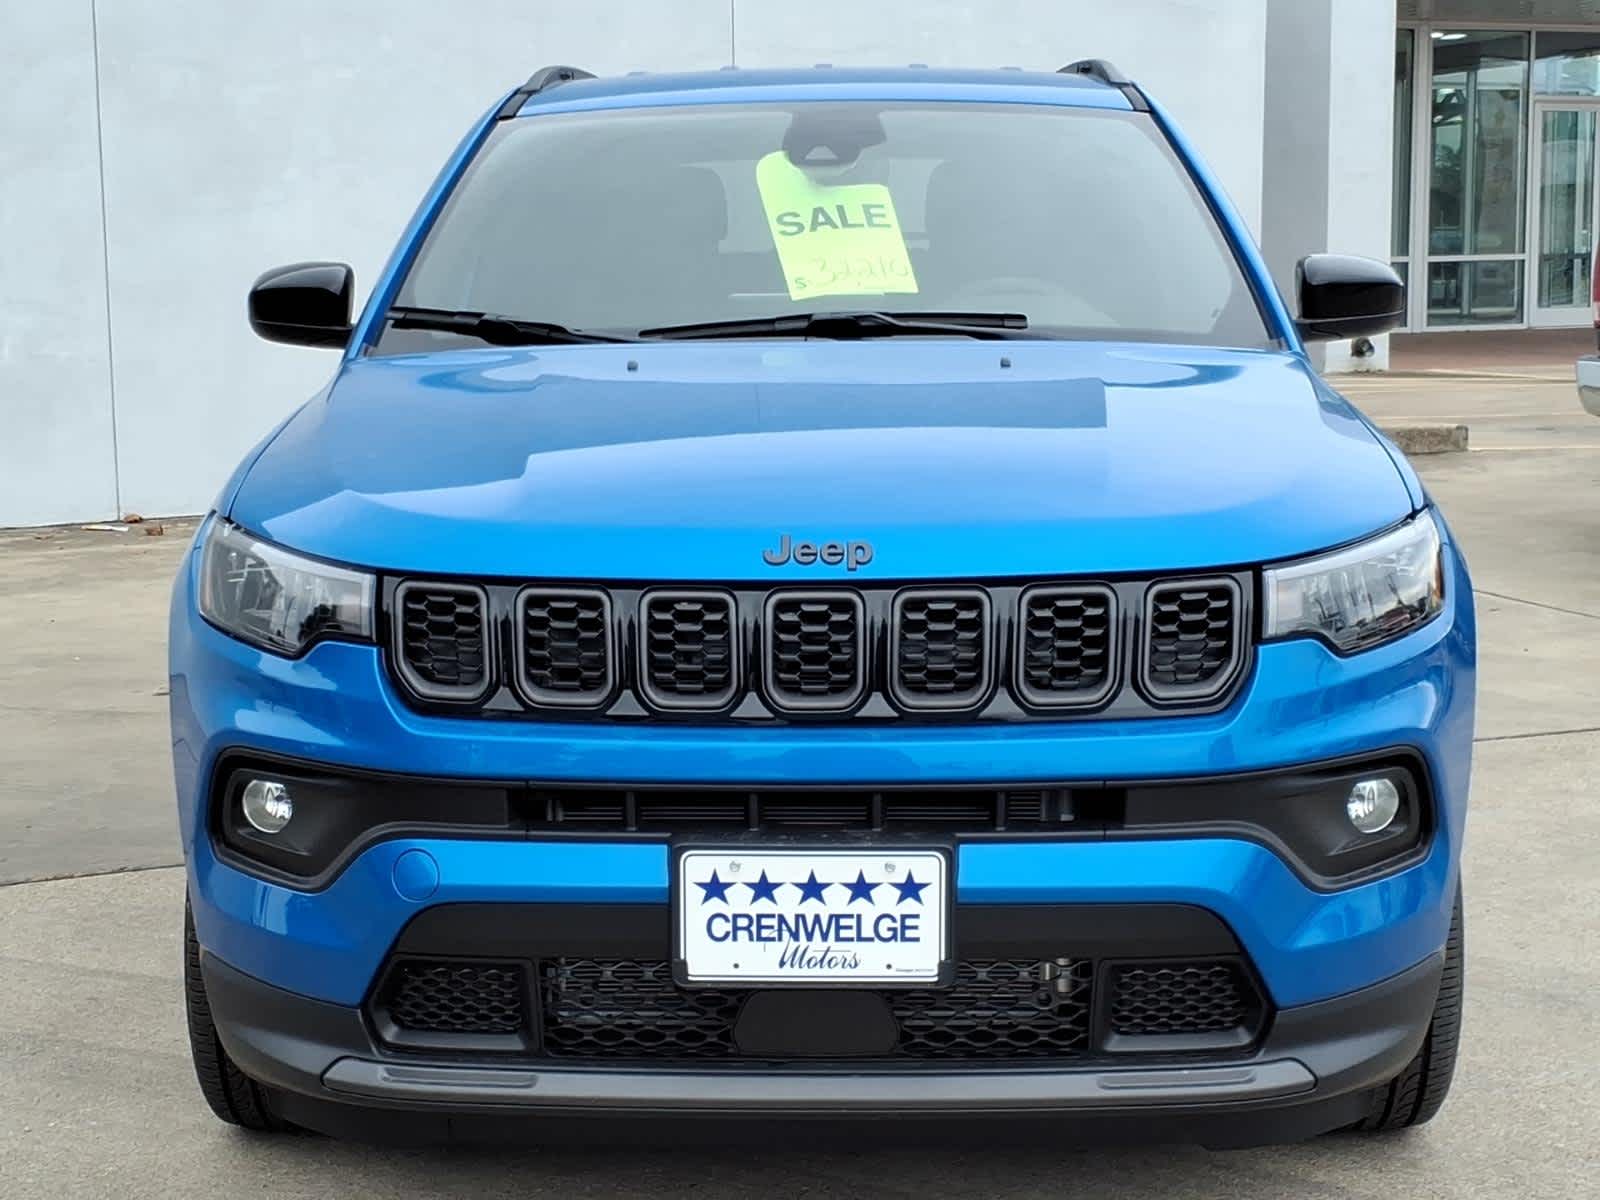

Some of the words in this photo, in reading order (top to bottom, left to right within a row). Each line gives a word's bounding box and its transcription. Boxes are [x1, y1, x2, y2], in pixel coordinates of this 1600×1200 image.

[775, 203, 892, 236] SALE
[763, 534, 873, 571] Jeep
[706, 912, 921, 943] CRENWELGE
[771, 934, 862, 970] Motors
